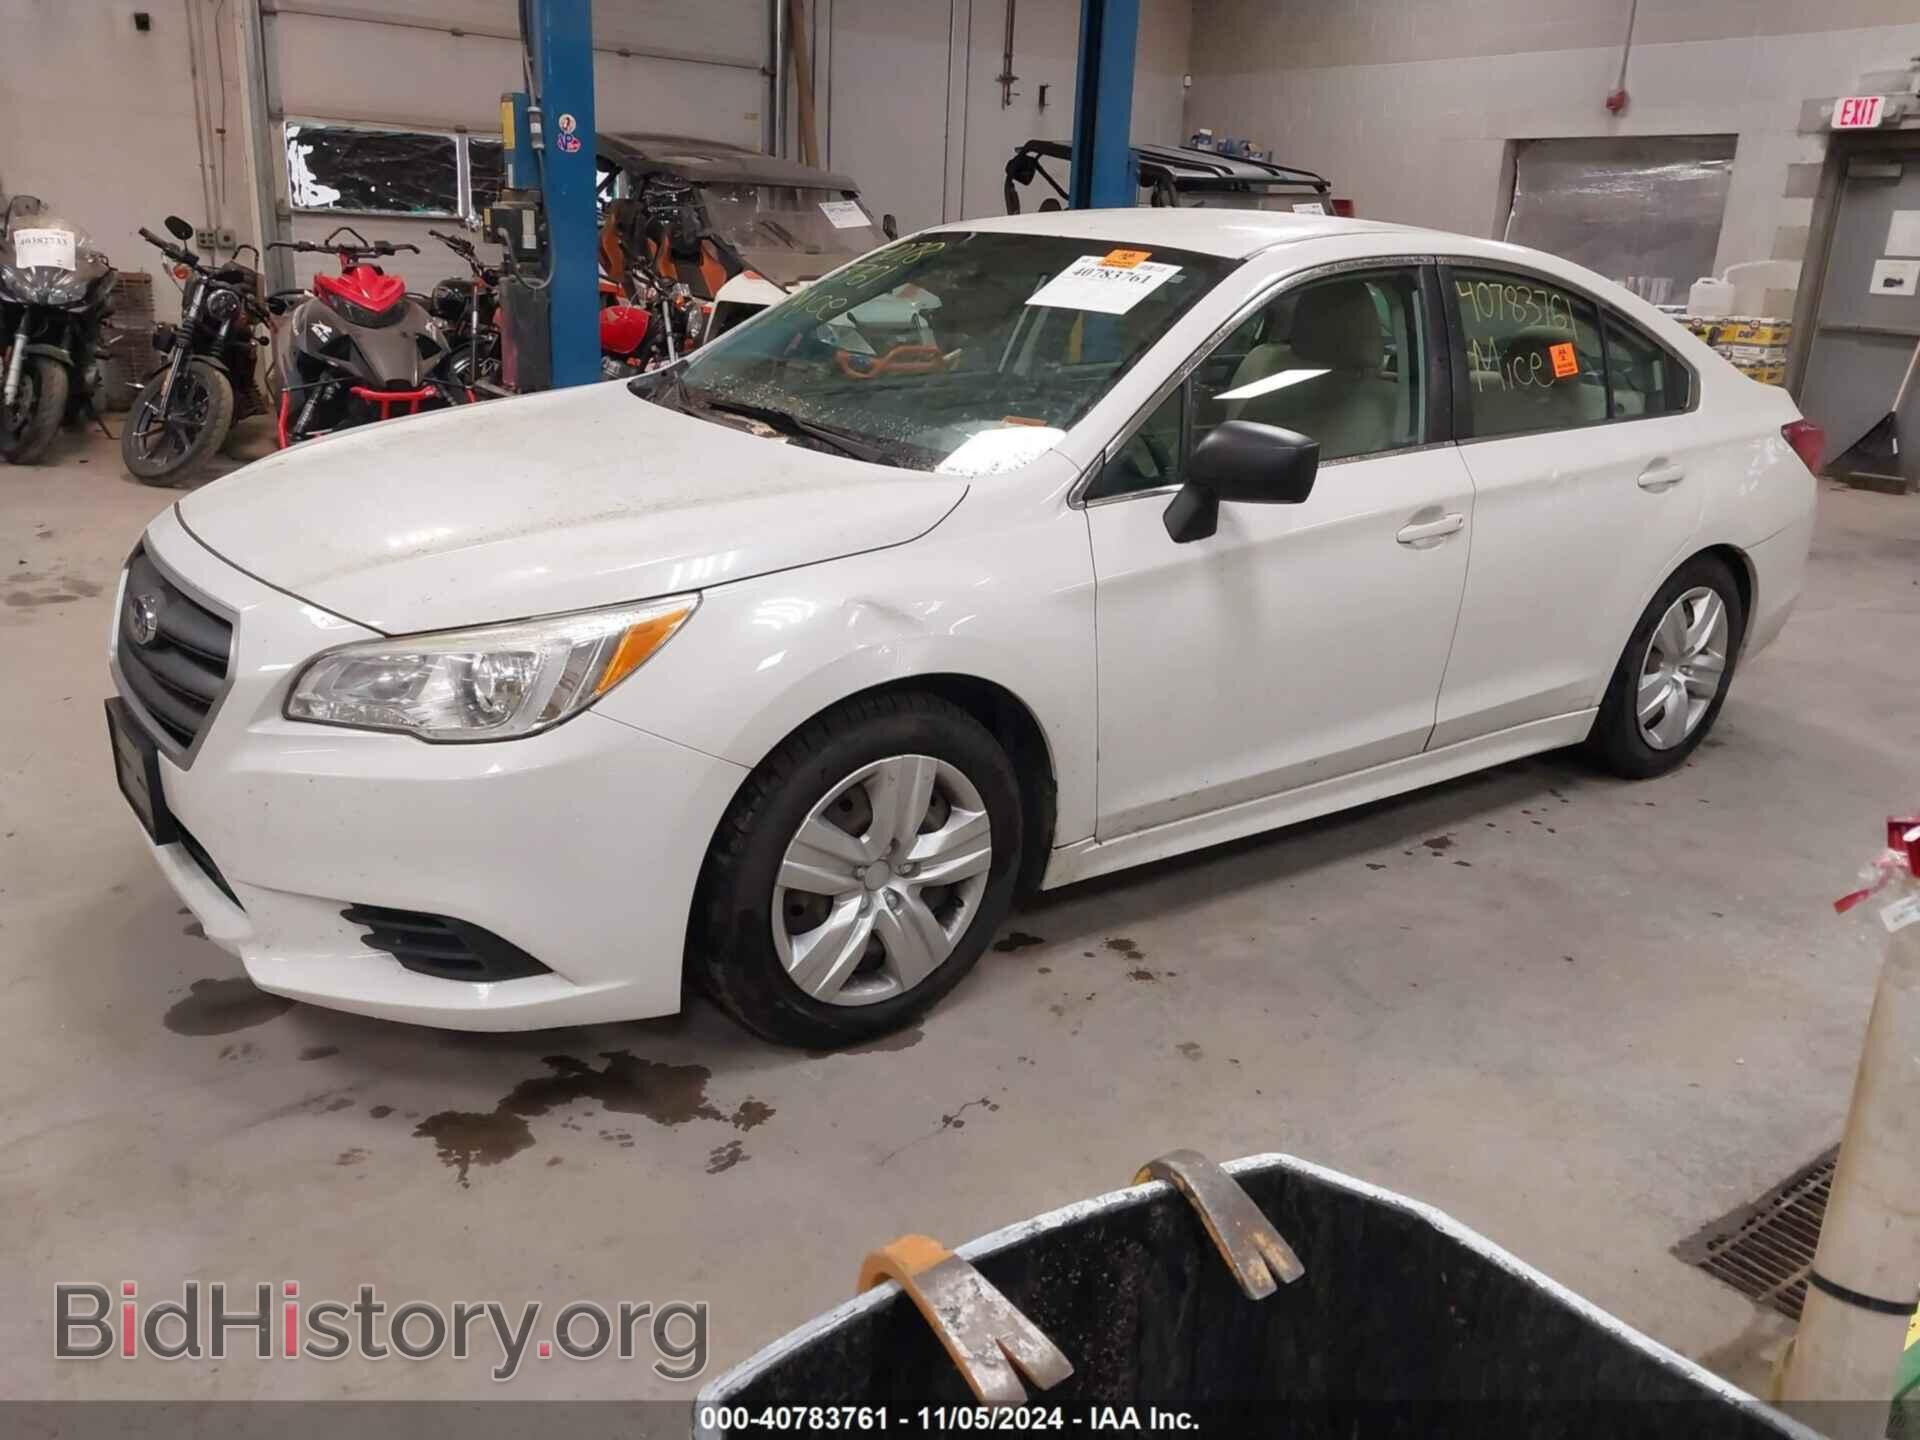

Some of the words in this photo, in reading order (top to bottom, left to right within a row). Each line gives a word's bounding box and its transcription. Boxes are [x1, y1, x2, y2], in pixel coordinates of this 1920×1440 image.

[1840, 98, 1879, 125] EXIT
[1072, 267, 1152, 285] 40783761
[1456, 280, 1578, 342] 40783761
[1472, 336, 1555, 392] Mice
